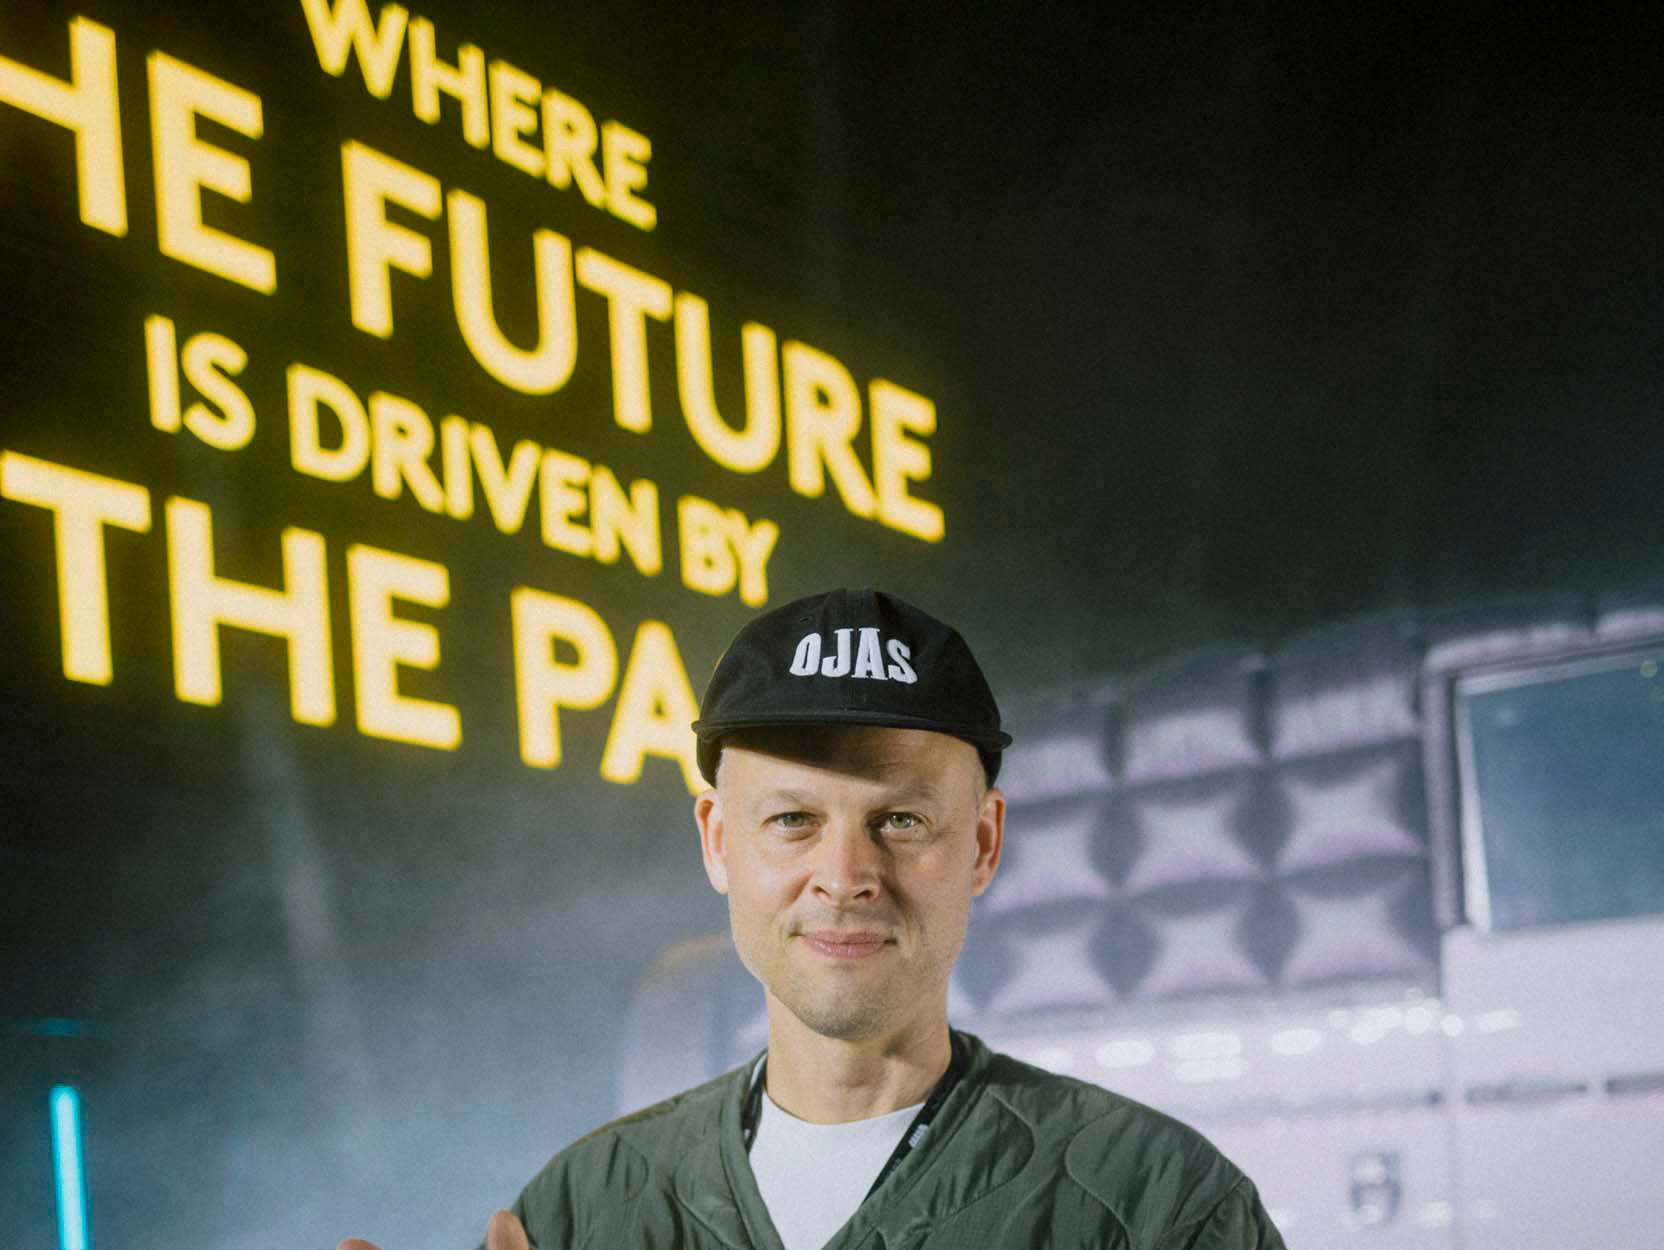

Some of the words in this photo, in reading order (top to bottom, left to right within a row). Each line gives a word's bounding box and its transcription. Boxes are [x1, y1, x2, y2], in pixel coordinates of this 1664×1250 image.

[302, 0, 656, 229] WHERE
[145, 316, 256, 451] IS
[287, 365, 662, 575] DRIVEN
[678, 496, 779, 607] BY
[342, 141, 943, 541] FUTURE
[0, 451, 462, 751] THE
[789, 627, 918, 684] OJAS
